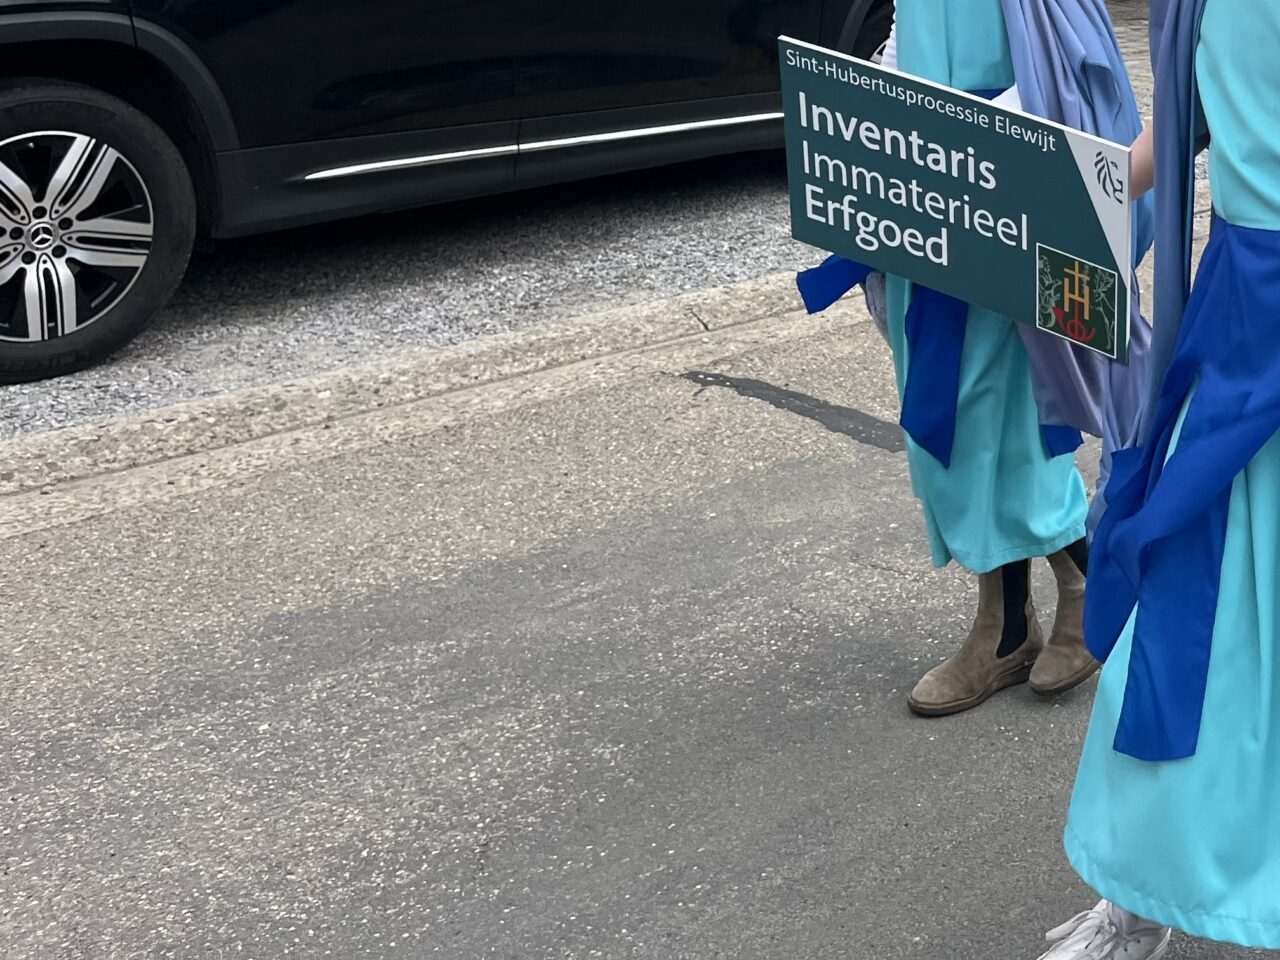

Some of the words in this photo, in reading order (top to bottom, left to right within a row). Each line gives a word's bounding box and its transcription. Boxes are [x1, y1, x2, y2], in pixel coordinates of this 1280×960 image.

[786, 49, 990, 128] Sint-Hubertusprocessie
[995, 116, 1056, 151] Elewijt
[799, 91, 997, 190] Inventaris
[802, 140, 1028, 250] Immaterieel
[805, 183, 948, 266] Erfgoed
